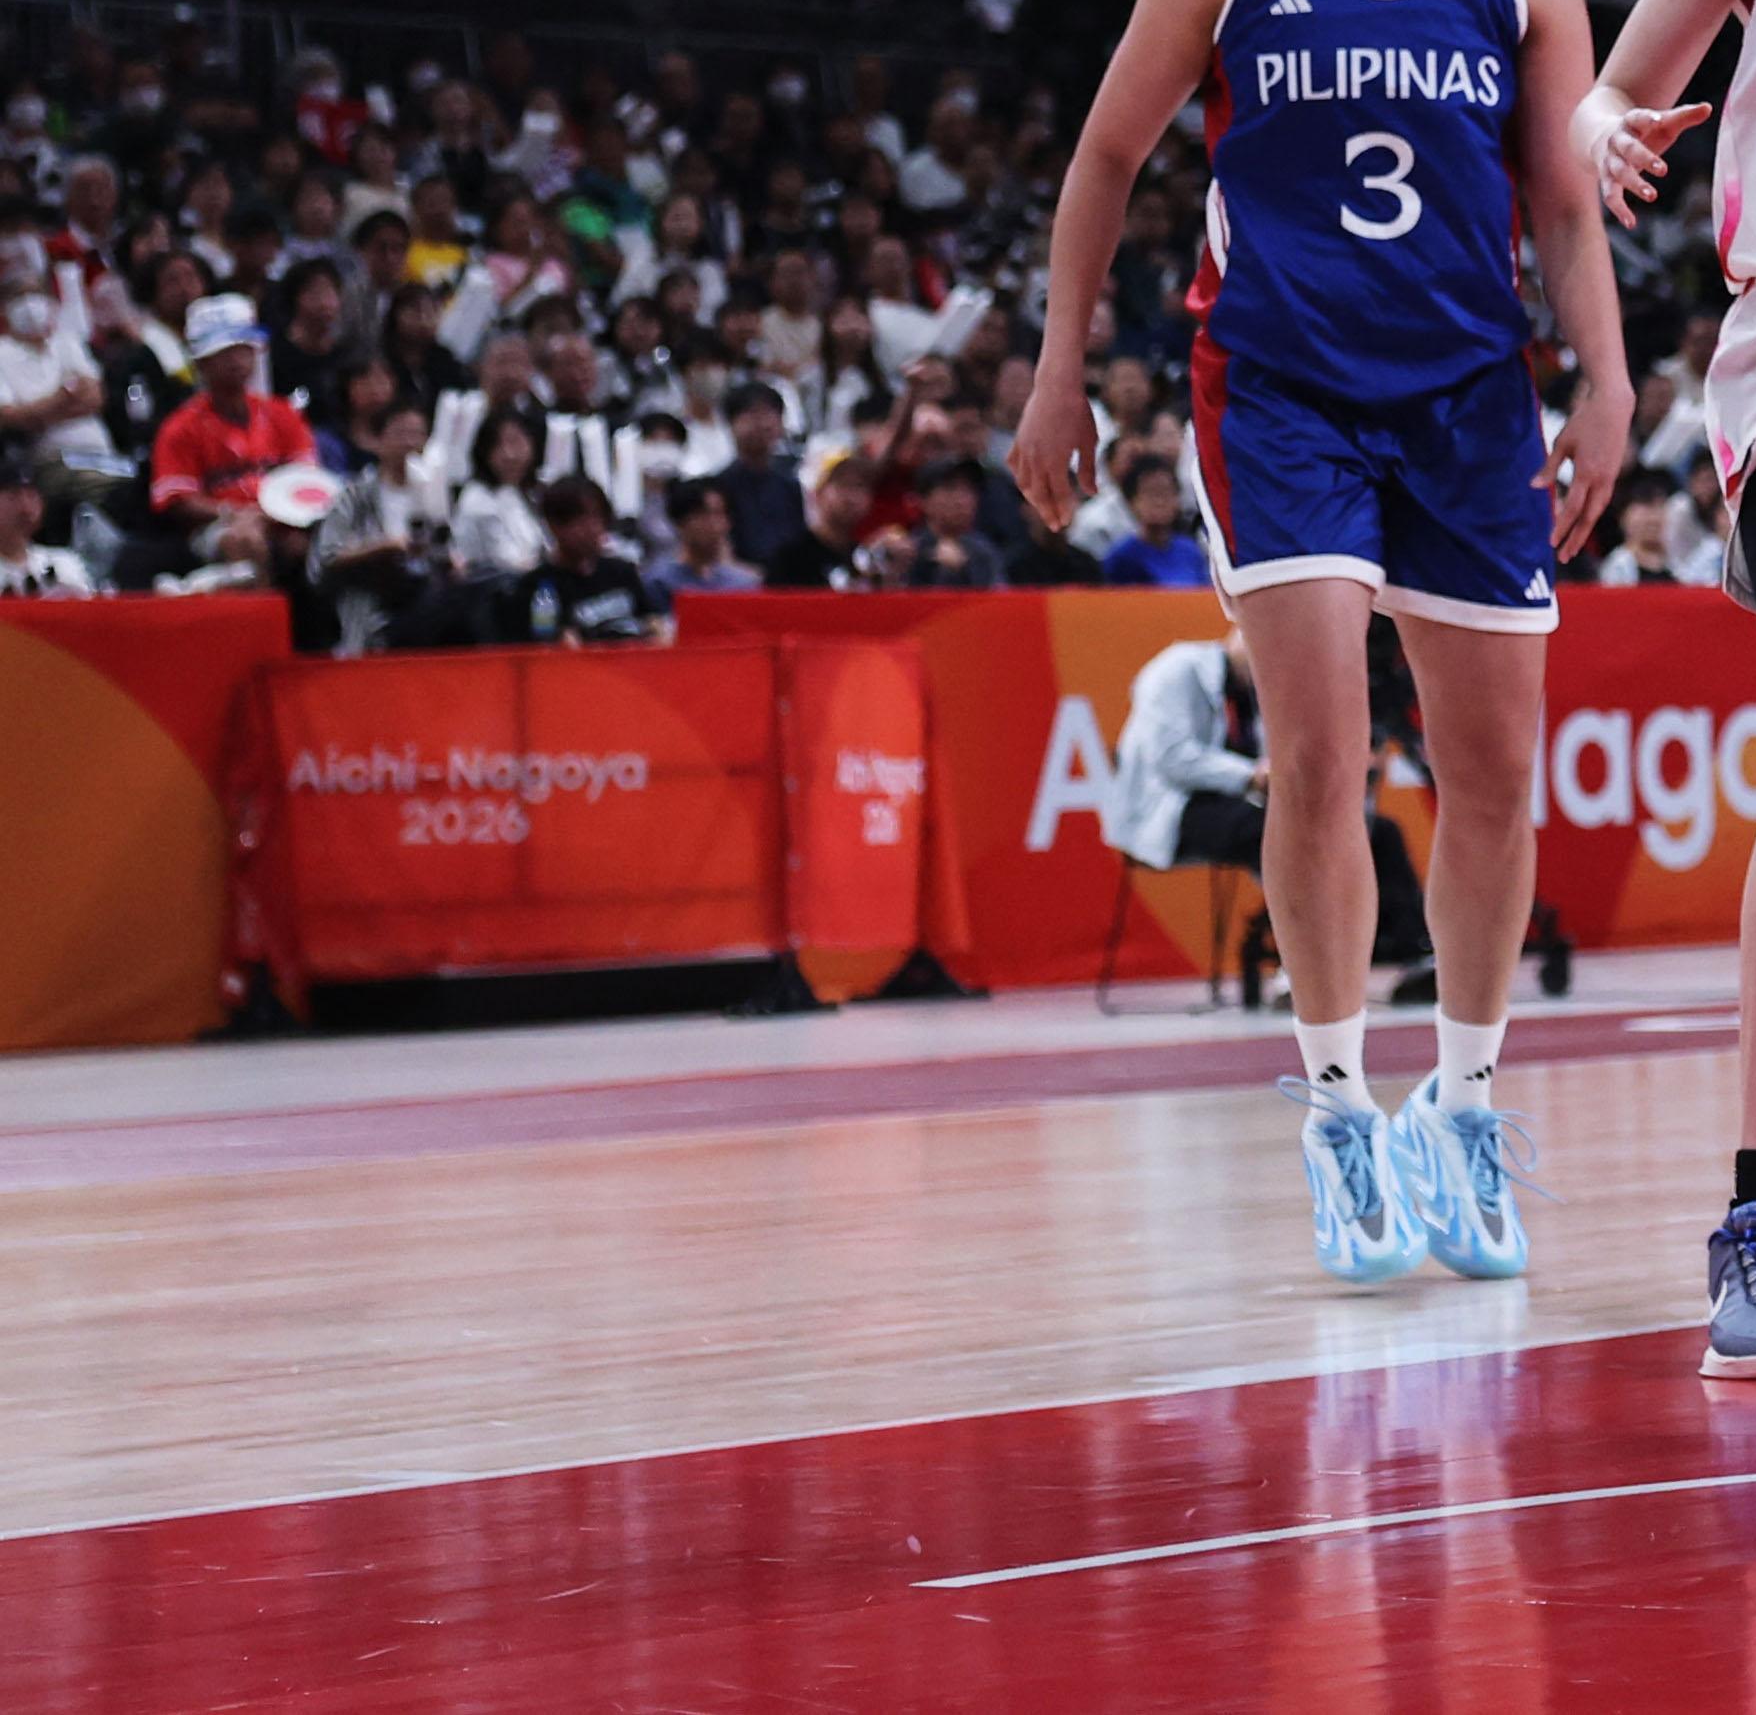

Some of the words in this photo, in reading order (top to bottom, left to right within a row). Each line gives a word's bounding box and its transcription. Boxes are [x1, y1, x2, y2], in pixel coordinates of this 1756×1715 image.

[1256, 48, 1501, 106] PILIPINAS
[1340, 131, 1422, 240] 3
[288, 744, 650, 804] Aichi-Nagoya
[401, 799, 531, 846] 2026
